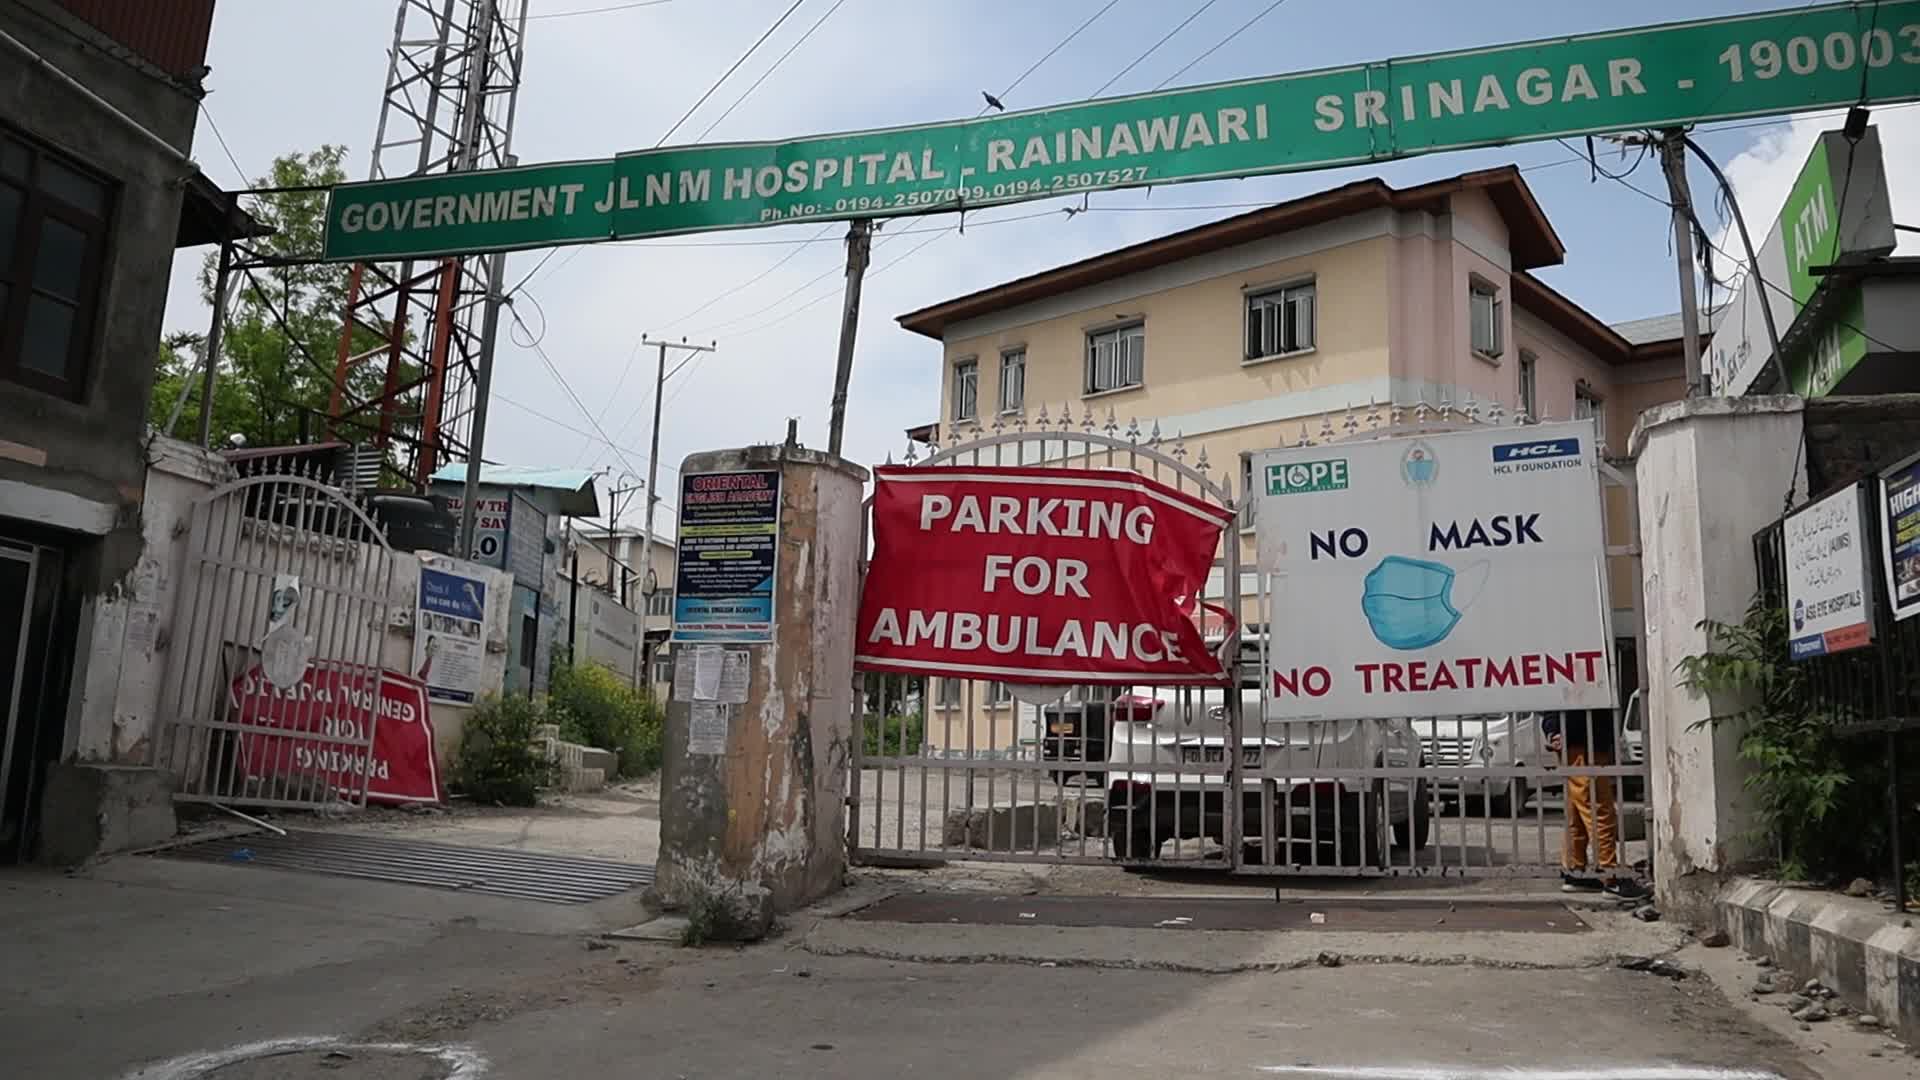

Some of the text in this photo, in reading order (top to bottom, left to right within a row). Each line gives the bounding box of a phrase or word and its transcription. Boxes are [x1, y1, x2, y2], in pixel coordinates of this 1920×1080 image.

[340, 184, 584, 233] GOVERNMENT
[594, 168, 711, 213] JLNM
[723, 149, 944, 200] HOSPITAL
[986, 103, 1270, 173] RAINAWARI
[1314, 57, 1646, 132] SRINAGAR
[1718, 24, 1920, 83] 190003
[1793, 183, 1829, 273] ATM
[692, 474, 768, 491] ORIENTAL
[1267, 443, 1564, 490] HOPE HCL
[1493, 459, 1582, 475] HCL FOUNDATION
[448, 499, 486, 511] SLW
[919, 494, 1155, 545] PARKING
[1310, 513, 1544, 560] NO MASK
[983, 555, 1090, 598] FOR
[867, 607, 1190, 665] AMBULANCE
[1273, 651, 1602, 698] NO TREATMENT
